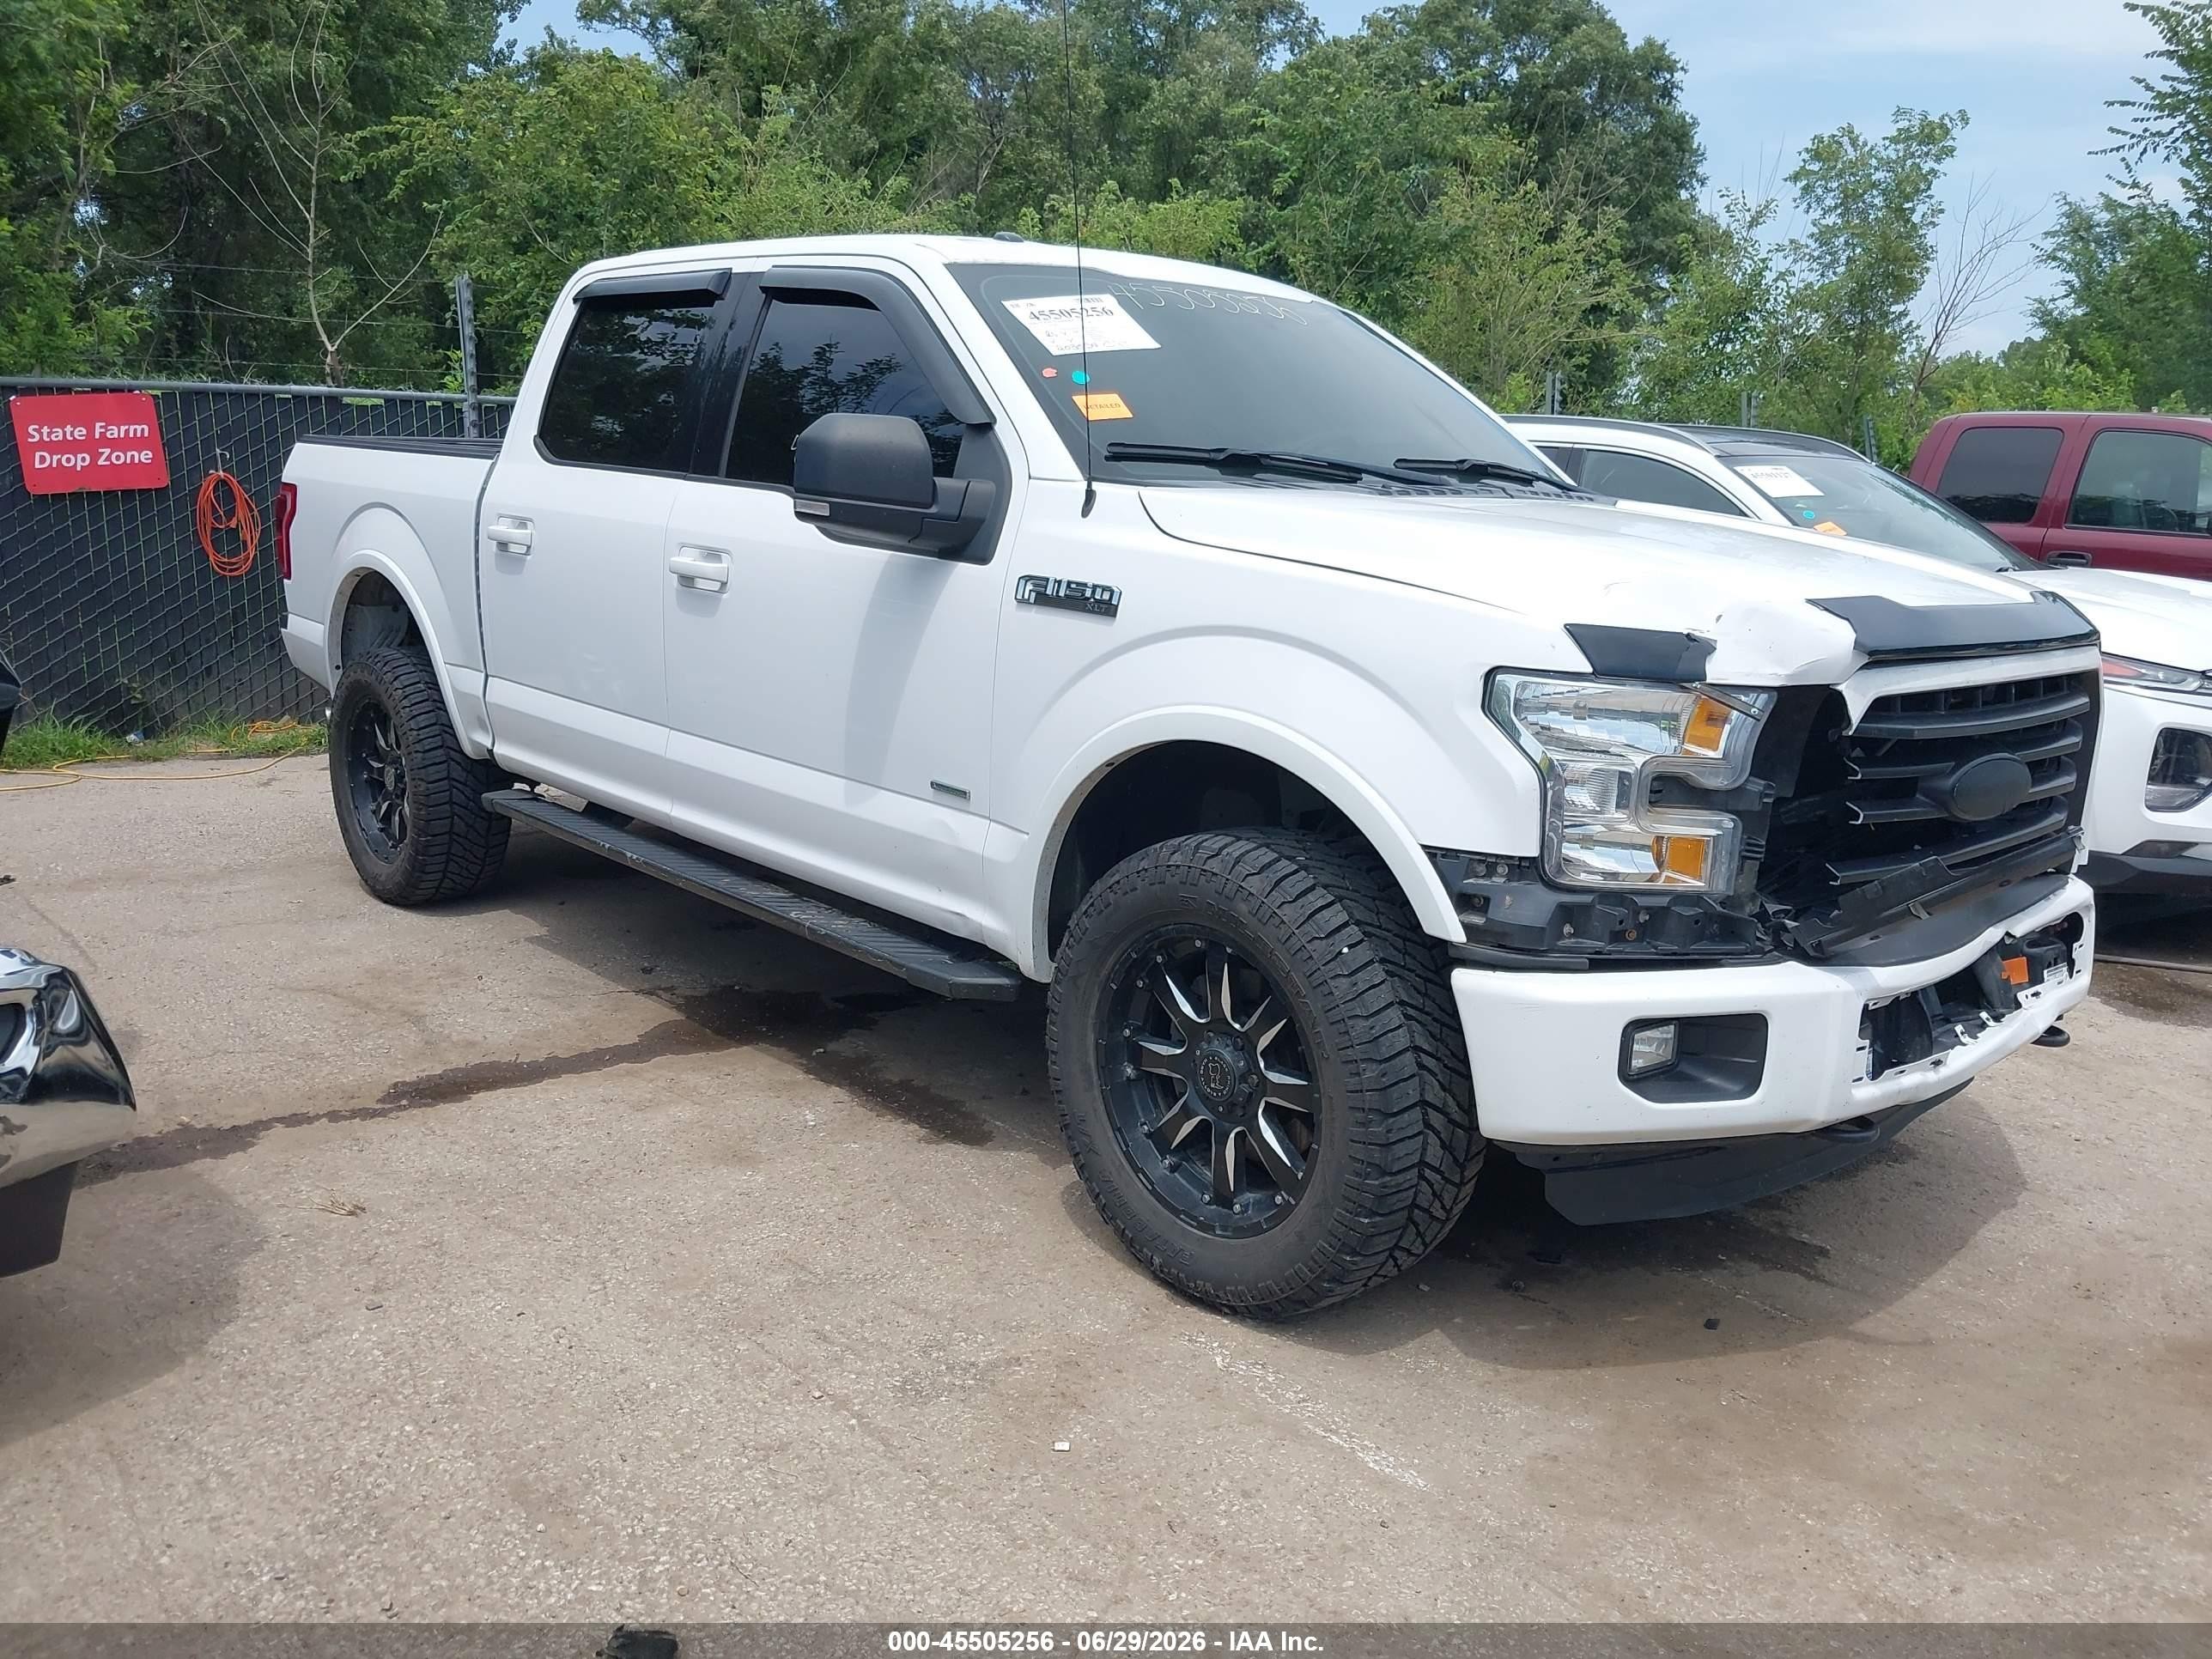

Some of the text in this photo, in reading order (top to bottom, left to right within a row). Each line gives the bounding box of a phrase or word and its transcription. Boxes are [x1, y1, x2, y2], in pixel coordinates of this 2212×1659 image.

[1029, 306, 1114, 322] 45505256
[27, 422, 149, 442] State Farm
[34, 448, 153, 471] Drop Zone
[1085, 603, 1109, 612] XLT
